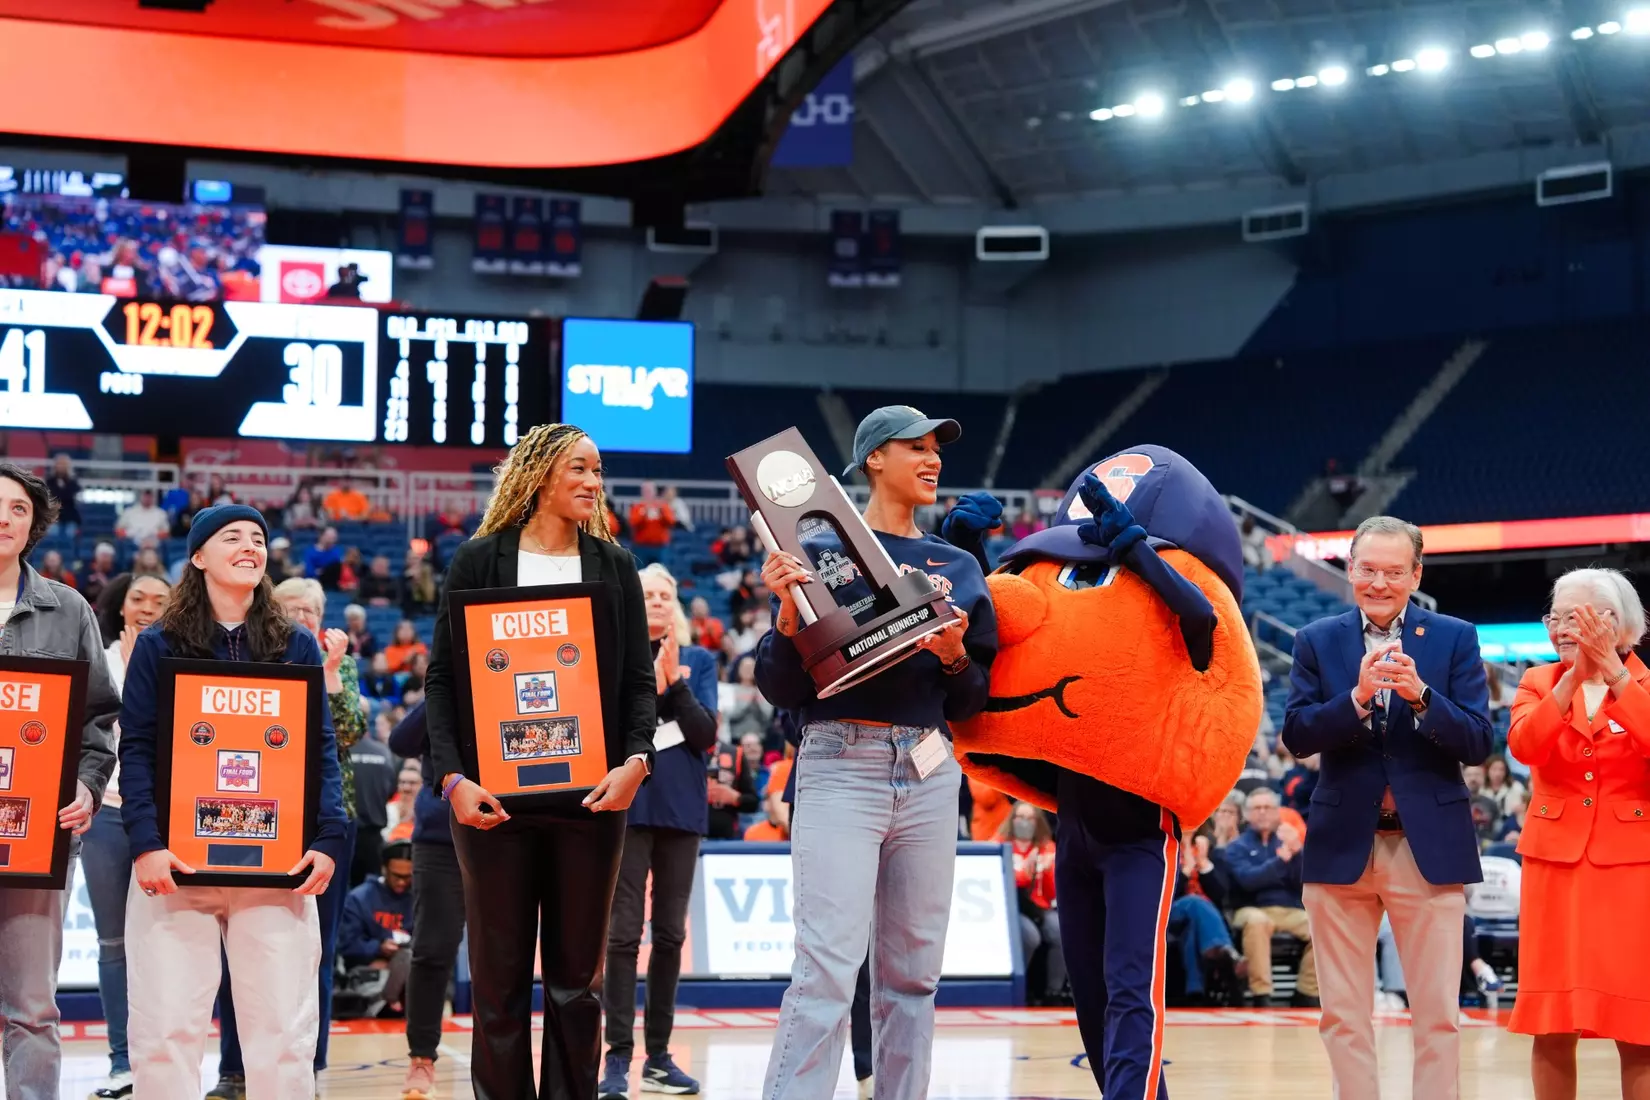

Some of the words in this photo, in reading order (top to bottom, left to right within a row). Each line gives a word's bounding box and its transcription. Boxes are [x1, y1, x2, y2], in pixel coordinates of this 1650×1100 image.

[124, 302, 214, 349] 12:02
[0, 328, 46, 393] 41
[282, 342, 343, 406] 30
[768, 467, 816, 501] NCAA
[797, 523, 828, 543] DIVISION
[801, 519, 817, 532] 2016
[820, 567, 836, 580] FINAL
[494, 610, 562, 638] 'CUSE
[848, 629, 889, 657] NATIONAL
[887, 608, 929, 636] RUNNER-UP
[204, 688, 273, 715] 'CUSE
